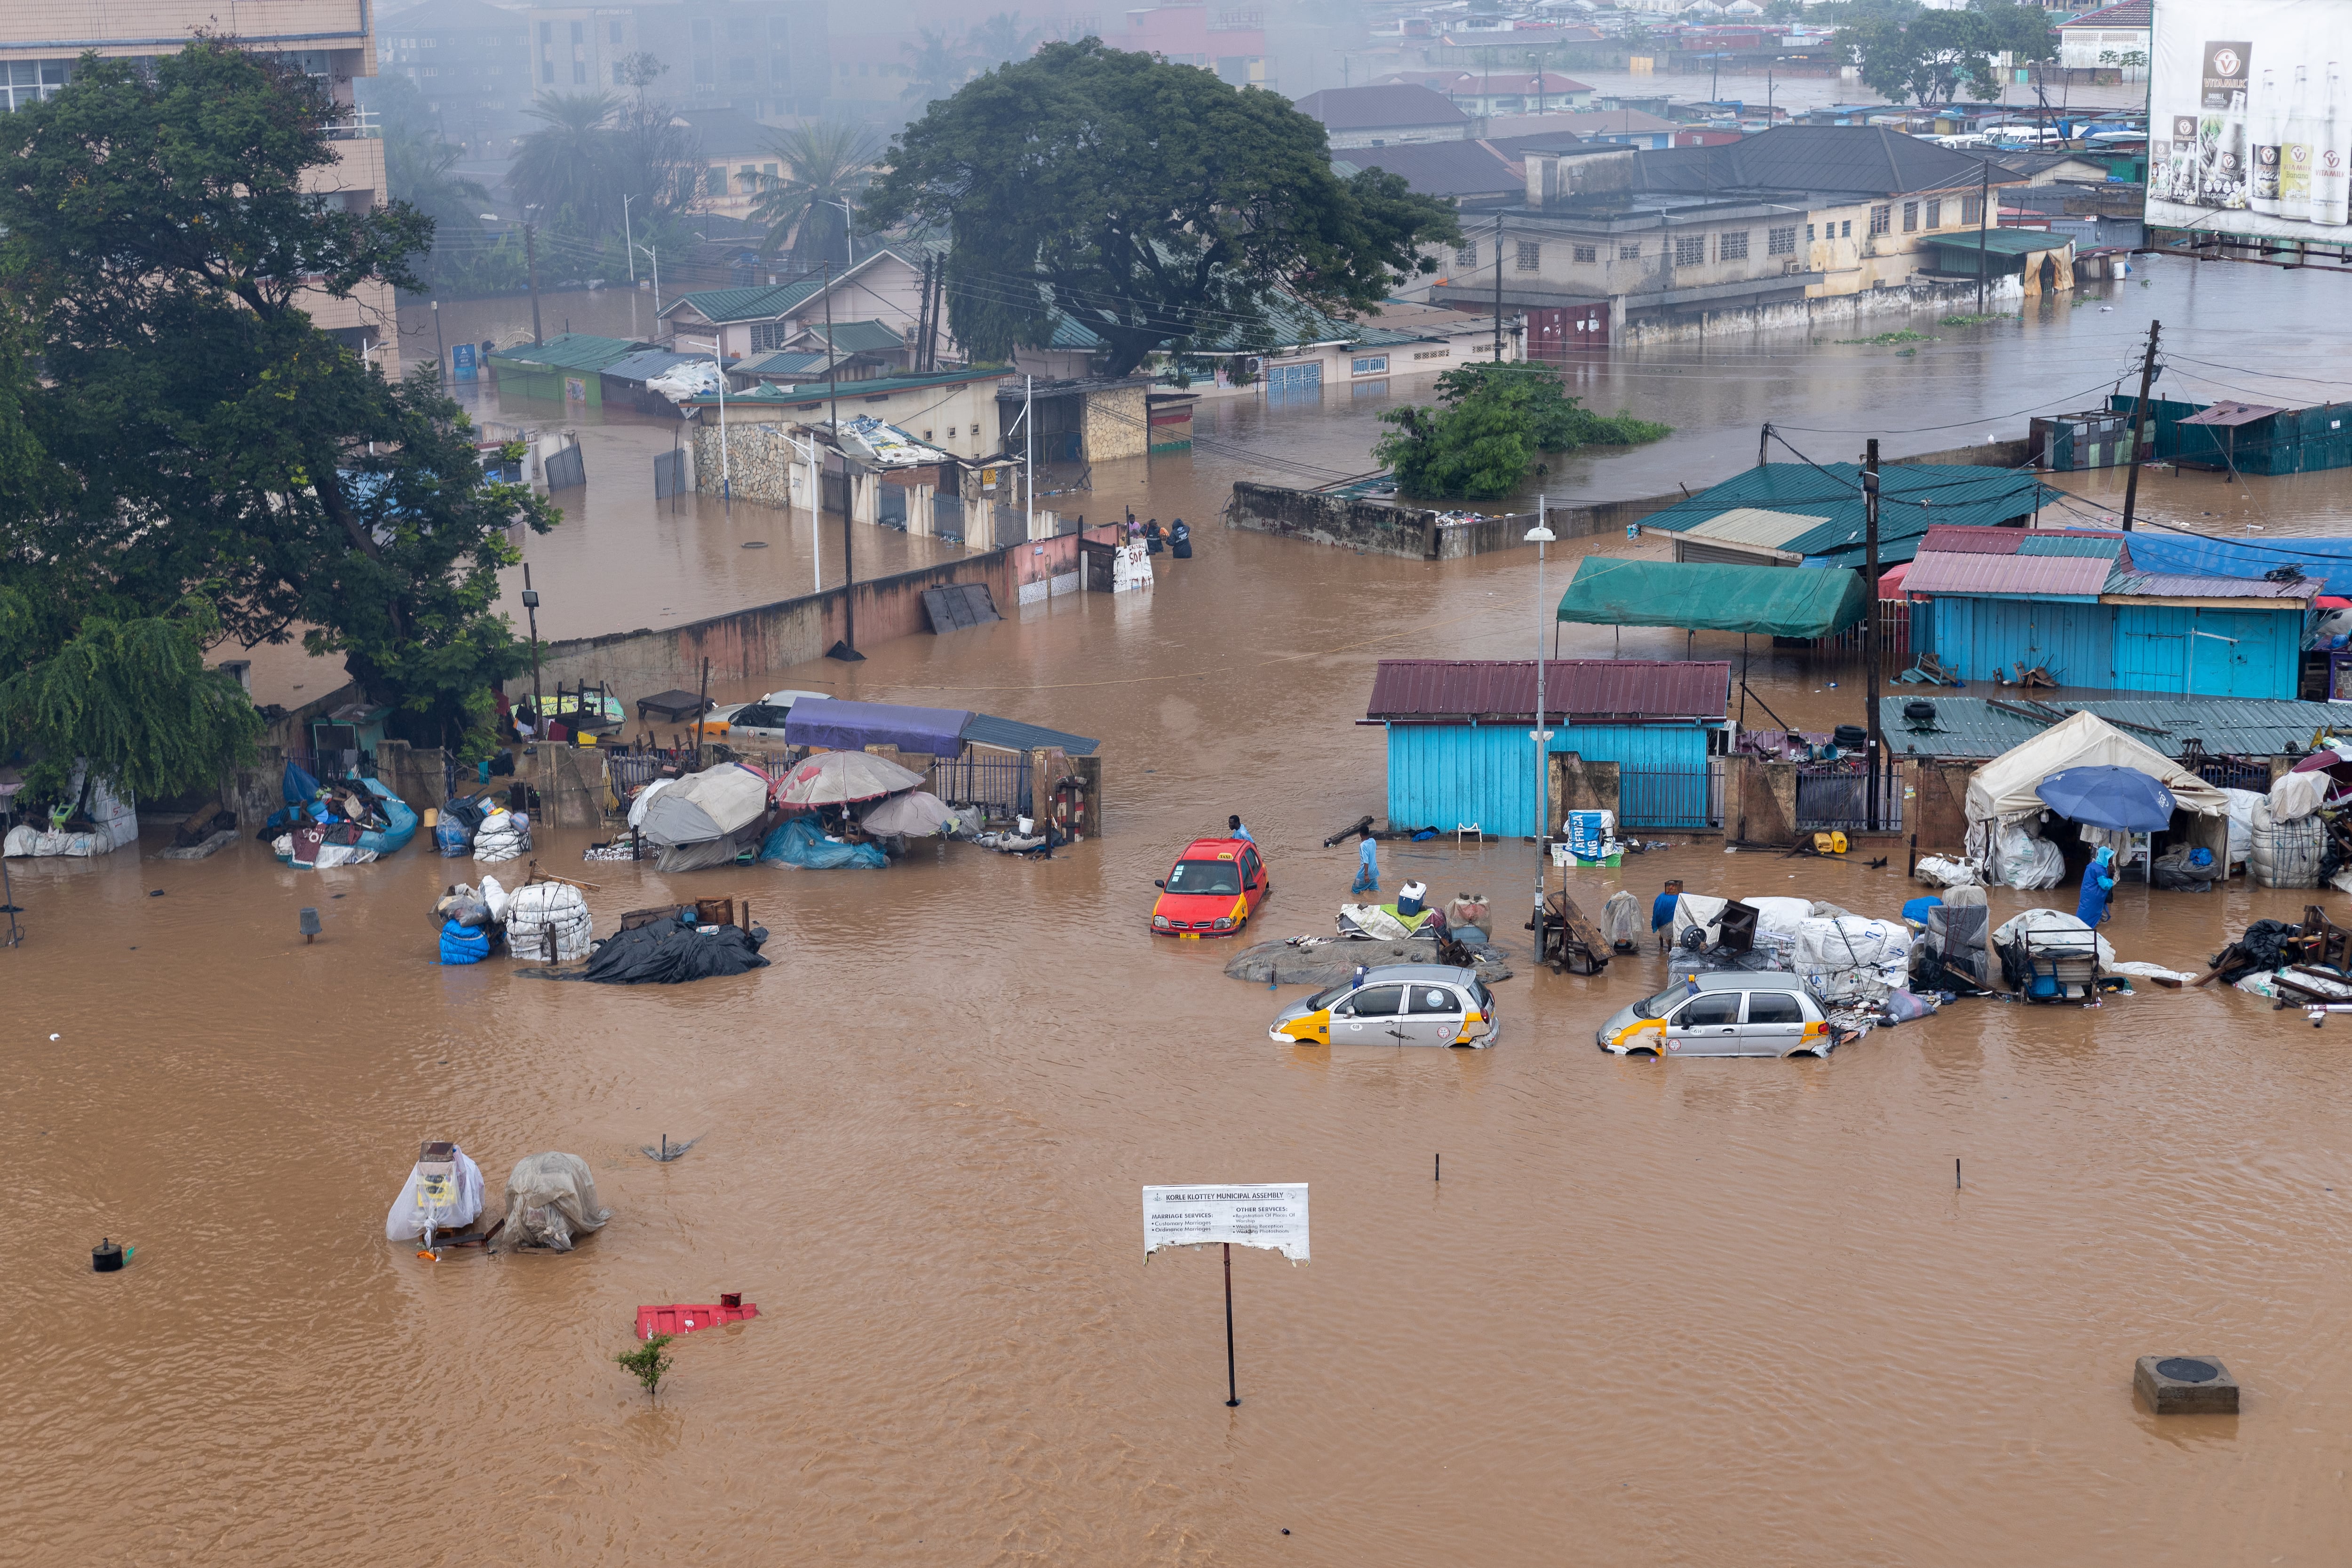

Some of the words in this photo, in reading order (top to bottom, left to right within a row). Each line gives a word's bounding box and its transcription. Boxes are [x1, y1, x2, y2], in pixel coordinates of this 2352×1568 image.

[2204, 79, 2246, 88] VITAMILK
[2316, 169, 2345, 177] VITAMILK
[1573, 815, 1585, 848] AFRICA
